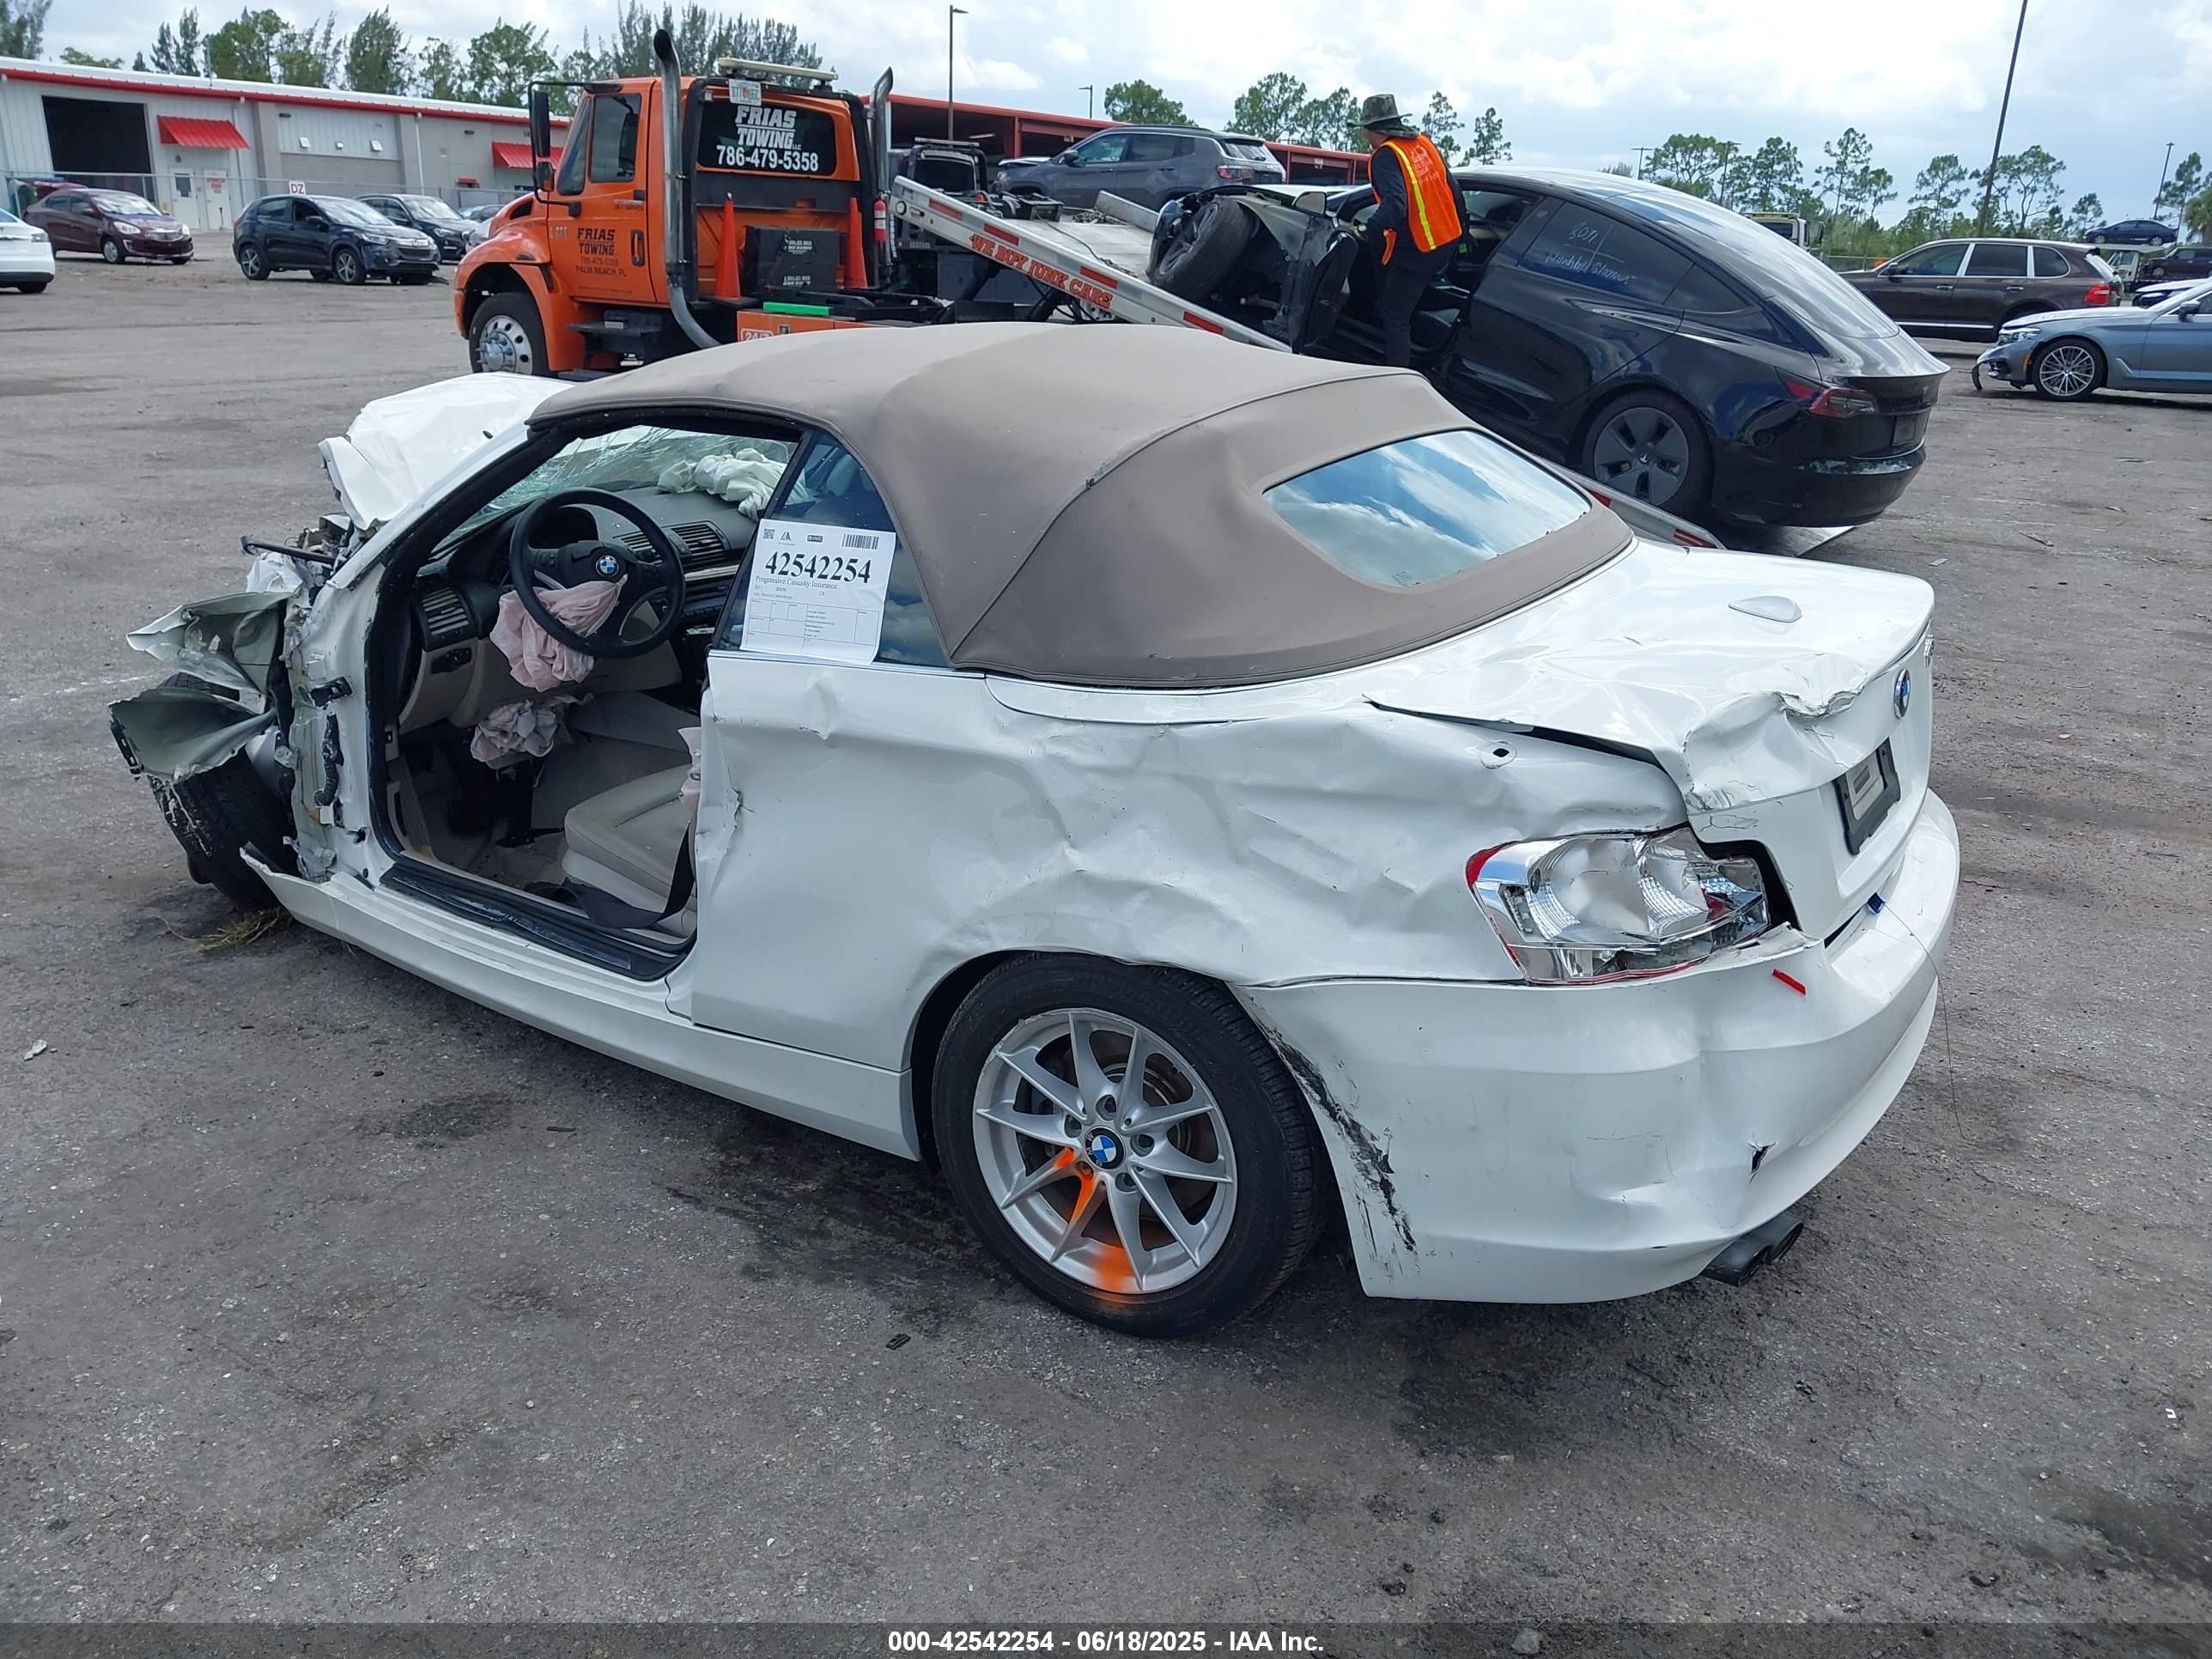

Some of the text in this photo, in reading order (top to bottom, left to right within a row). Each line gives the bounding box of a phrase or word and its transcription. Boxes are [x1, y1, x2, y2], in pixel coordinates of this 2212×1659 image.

[735, 106, 797, 129] FRIAS
[738, 128, 795, 149] TOWING
[716, 145, 819, 172] 786-479-5358
[291, 184, 304, 194] DZ
[577, 228, 616, 241] FRIAS
[579, 243, 615, 256] TOWING
[576, 265, 594, 275] PALM
[971, 234, 1114, 309] WE BUY JUNK CARS
[765, 550, 872, 584] 42542254
[755, 575, 838, 590] Progressive Casualty Insurance
